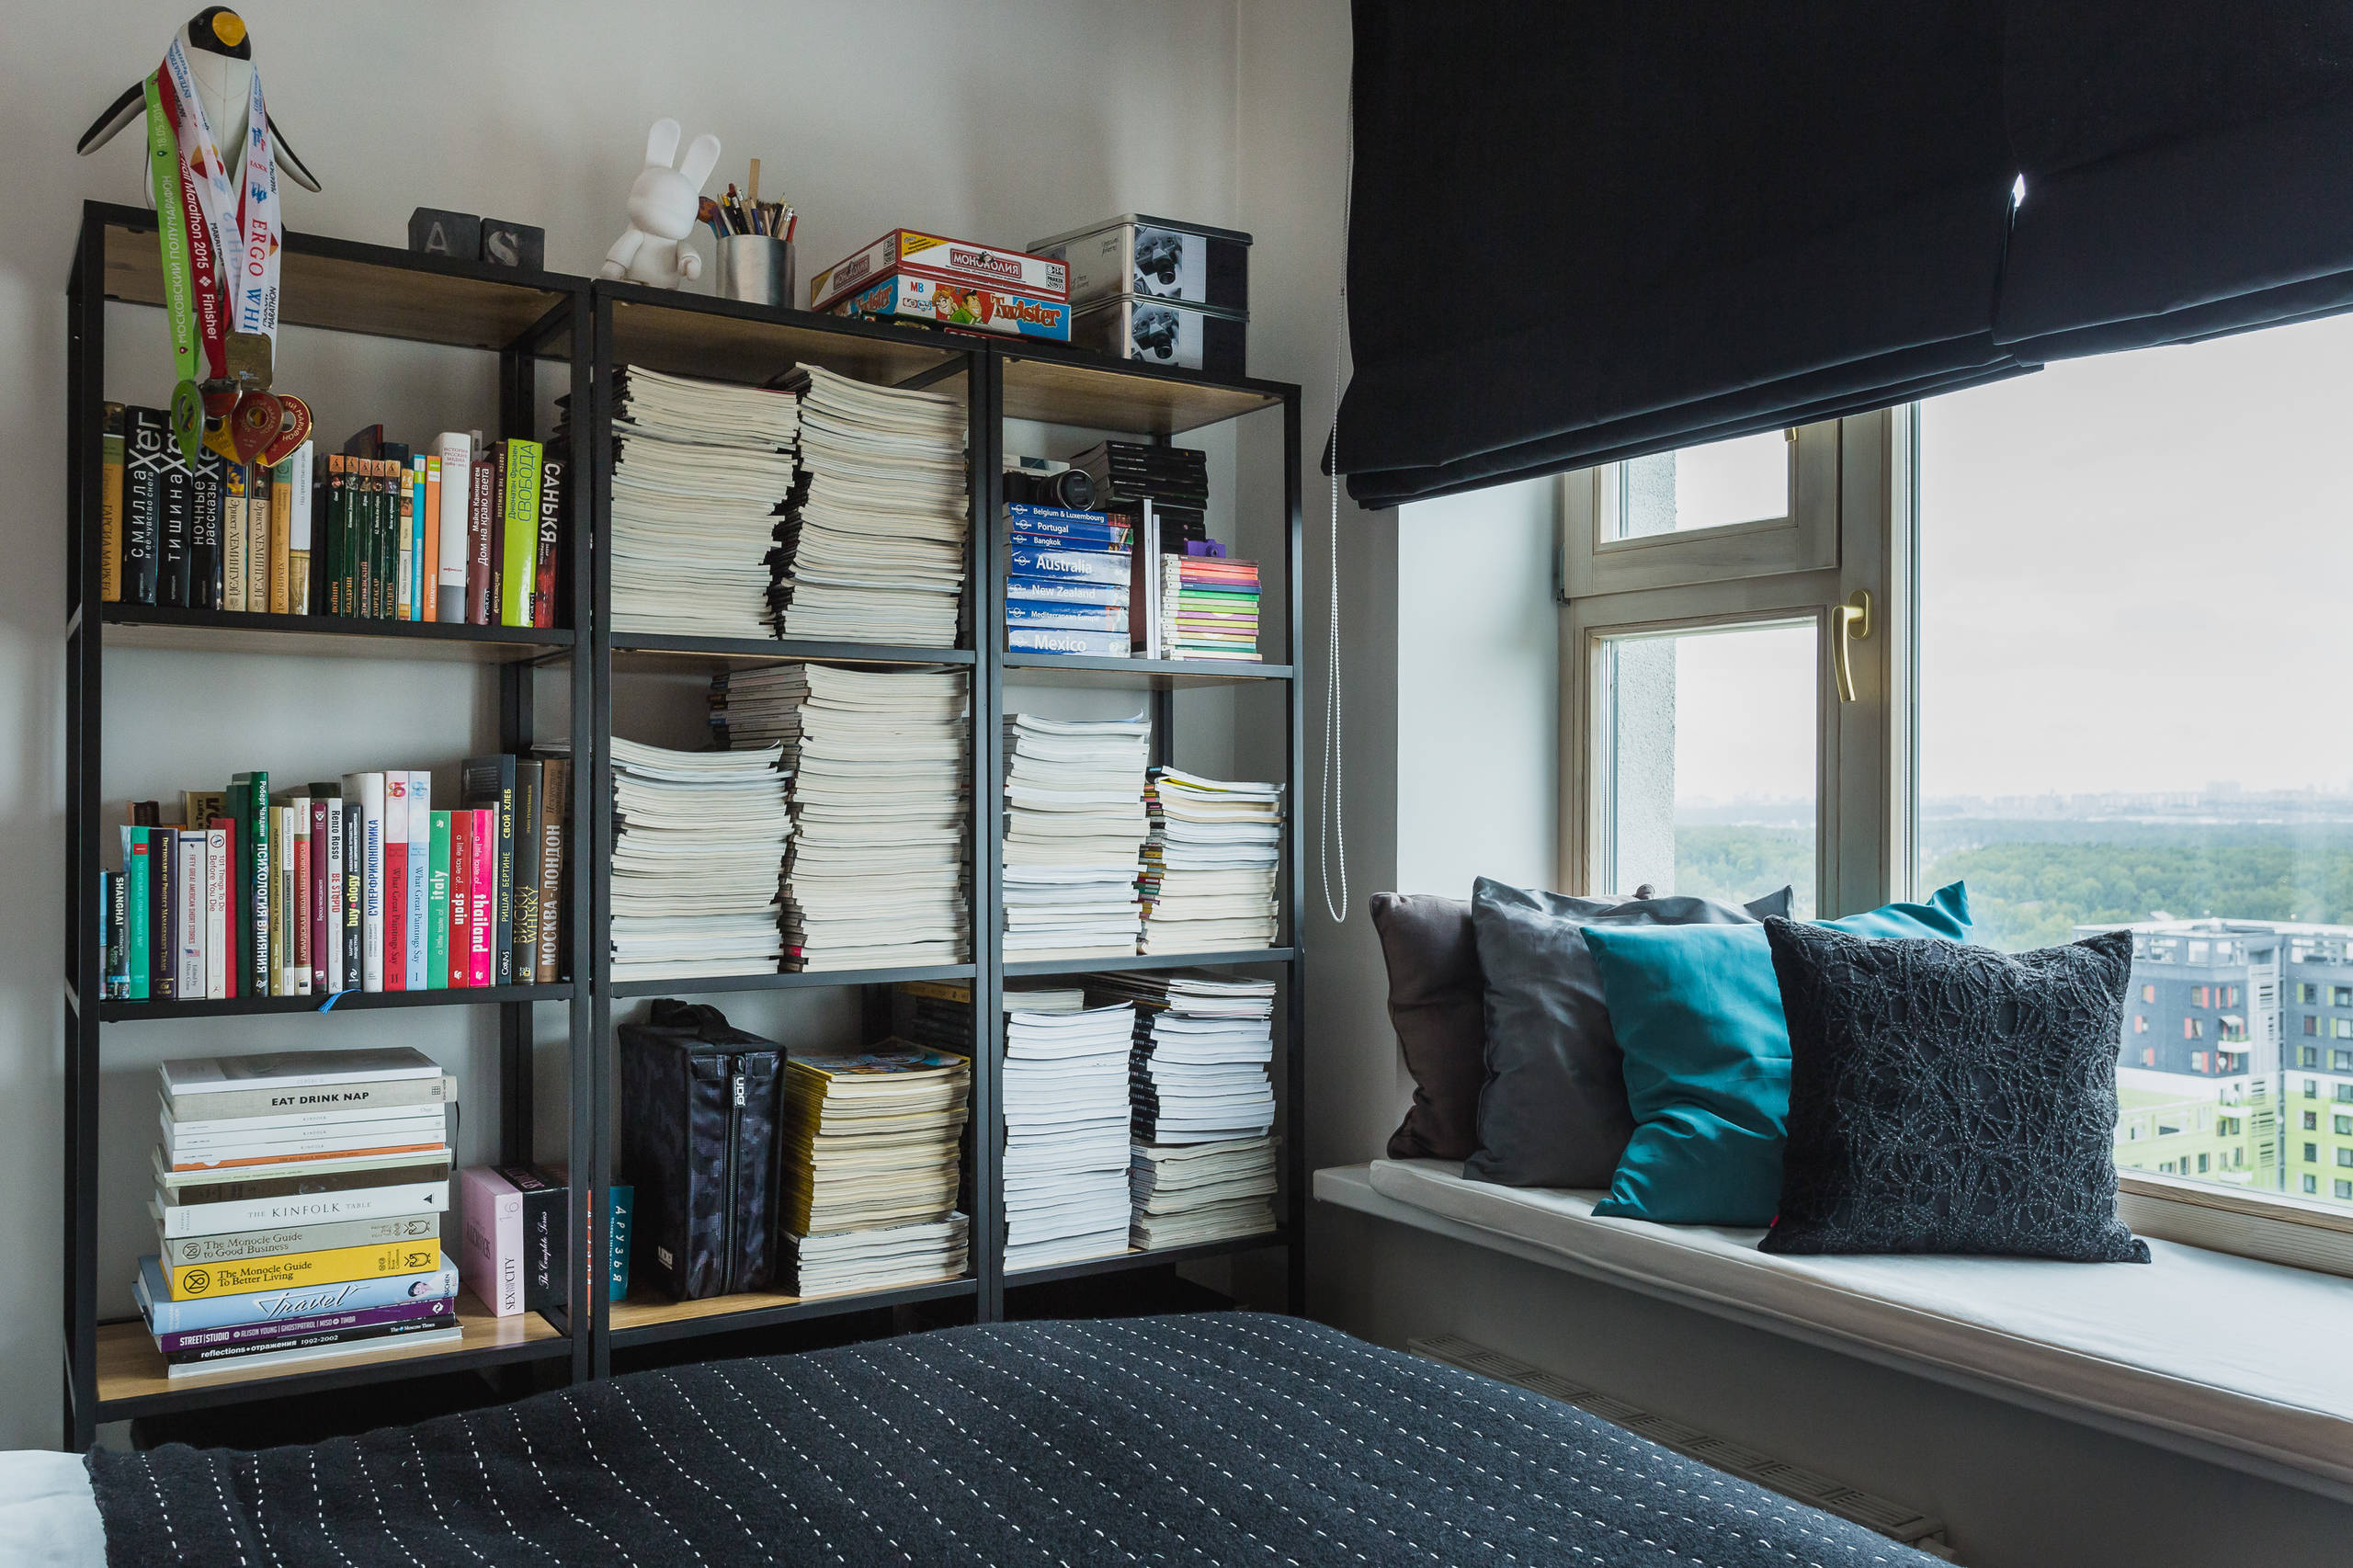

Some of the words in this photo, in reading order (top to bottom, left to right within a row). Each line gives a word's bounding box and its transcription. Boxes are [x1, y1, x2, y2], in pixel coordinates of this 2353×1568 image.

[163, 176, 180, 259] ПОЛУМАРАФОН
[184, 181, 202, 239] Marathon
[194, 242, 210, 269] 2015
[248, 219, 267, 277] ERGO
[425, 222, 450, 256] A
[488, 230, 520, 267] S
[910, 281, 924, 293] MB
[169, 262, 187, 344] МОСКОВСКИЙ
[268, 287, 277, 329] MARATHON
[991, 293, 1062, 327] Twister
[201, 293, 217, 340] Finisher
[281, 409, 305, 441] МАРАФОН
[128, 412, 161, 473] Хёг
[509, 445, 518, 479] Франзен
[145, 472, 154, 498] снега
[472, 467, 481, 506] Каннингем
[480, 468, 490, 496] света
[517, 444, 536, 522] СВОБОДА
[480, 498, 490, 526] краю
[508, 481, 517, 520] Джонатан
[540, 462, 561, 543] САНЬКЯ
[144, 500, 154, 538] чувство
[205, 482, 217, 546] рассказы
[229, 499, 241, 530] Эрнест
[255, 502, 266, 533] Эрнест
[472, 508, 480, 532] Майкл
[1033, 507, 1059, 517] Belgium
[1066, 511, 1105, 523] Luxembourg
[479, 527, 489, 541] на
[1037, 522, 1069, 534] Portugal
[478, 542, 490, 566] Дом
[1033, 537, 1062, 546] Bangkok
[229, 531, 242, 597] ХЕМИНГУЭЙ
[255, 534, 267, 597] ХЕМИНГУЭЙ
[1036, 555, 1092, 574] Australia
[1031, 585, 1055, 597] New
[1057, 586, 1096, 598] Zealand
[1034, 634, 1087, 653] Mexico
[258, 780, 267, 806] Роберт
[503, 789, 511, 811] ХЛЕБ
[332, 811, 341, 834] Renzo
[501, 814, 510, 838] СВОЙ
[332, 835, 341, 860] Rosso
[473, 842, 482, 857] little
[544, 824, 561, 892] ЛОНДОН
[209, 855, 217, 880] Before
[256, 843, 268, 918] ПСИХОЛОГИЯ
[332, 873, 340, 882] BE
[368, 819, 379, 916] СУПЕРФРИКОНОМИКА
[392, 867, 402, 888] What
[414, 867, 424, 888] What
[502, 851, 511, 888] БЕРТИНЕ
[209, 881, 217, 897] You
[218, 892, 224, 901] To
[430, 870, 449, 900] italy
[115, 877, 124, 926] SHANGHAI
[209, 899, 217, 912] Die
[218, 903, 224, 912] Do
[299, 891, 307, 916] ШКОЛА
[391, 891, 401, 911] Great
[414, 890, 423, 911] Great
[451, 892, 468, 925] spain
[502, 892, 510, 922] РИШАР
[472, 893, 489, 952] thailand
[527, 885, 539, 944] WHISKY
[299, 916, 307, 961] ГАРВАРДСКАЯ
[390, 913, 400, 949] Paintings
[413, 913, 423, 949] Paintings
[541, 901, 558, 965] МОСКВА
[256, 920, 267, 972] ВЛИЯНИЯ
[390, 951, 399, 965] Say
[411, 949, 422, 963] Say
[271, 1096, 295, 1107] EAT
[300, 1094, 339, 1104] DRINK
[344, 1092, 369, 1101] NAP
[735, 1075, 745, 1106] UDG
[272, 1202, 341, 1218] KINFOLK
[346, 1201, 372, 1210] TABLE
[537, 1210, 549, 1235] Series
[203, 1250, 213, 1258] to
[215, 1246, 244, 1257] Good
[247, 1243, 289, 1255] Business
[204, 1241, 225, 1250] The
[228, 1235, 270, 1248] Monocle
[272, 1233, 302, 1243] Guide
[538, 1236, 551, 1270] Complete
[612, 1205, 627, 1282] ДРУЗЬЯ
[217, 1269, 237, 1279] The
[240, 1265, 281, 1277] Monocle
[283, 1261, 313, 1271] Guide
[218, 1278, 230, 1287] To
[233, 1276, 260, 1286] Better
[263, 1272, 294, 1282] Living
[505, 1257, 516, 1283] CITY
[539, 1272, 550, 1290] The
[506, 1292, 516, 1311] SEX
[240, 1328, 259, 1338] ALISON
[260, 1325, 278, 1335] YOUNG
[280, 1322, 316, 1334] GHOSTPATROL
[319, 1319, 333, 1328] MISO
[200, 1346, 245, 1358] reflections
[251, 1339, 297, 1352] отражения
[301, 1335, 339, 1345] 1992-2002
